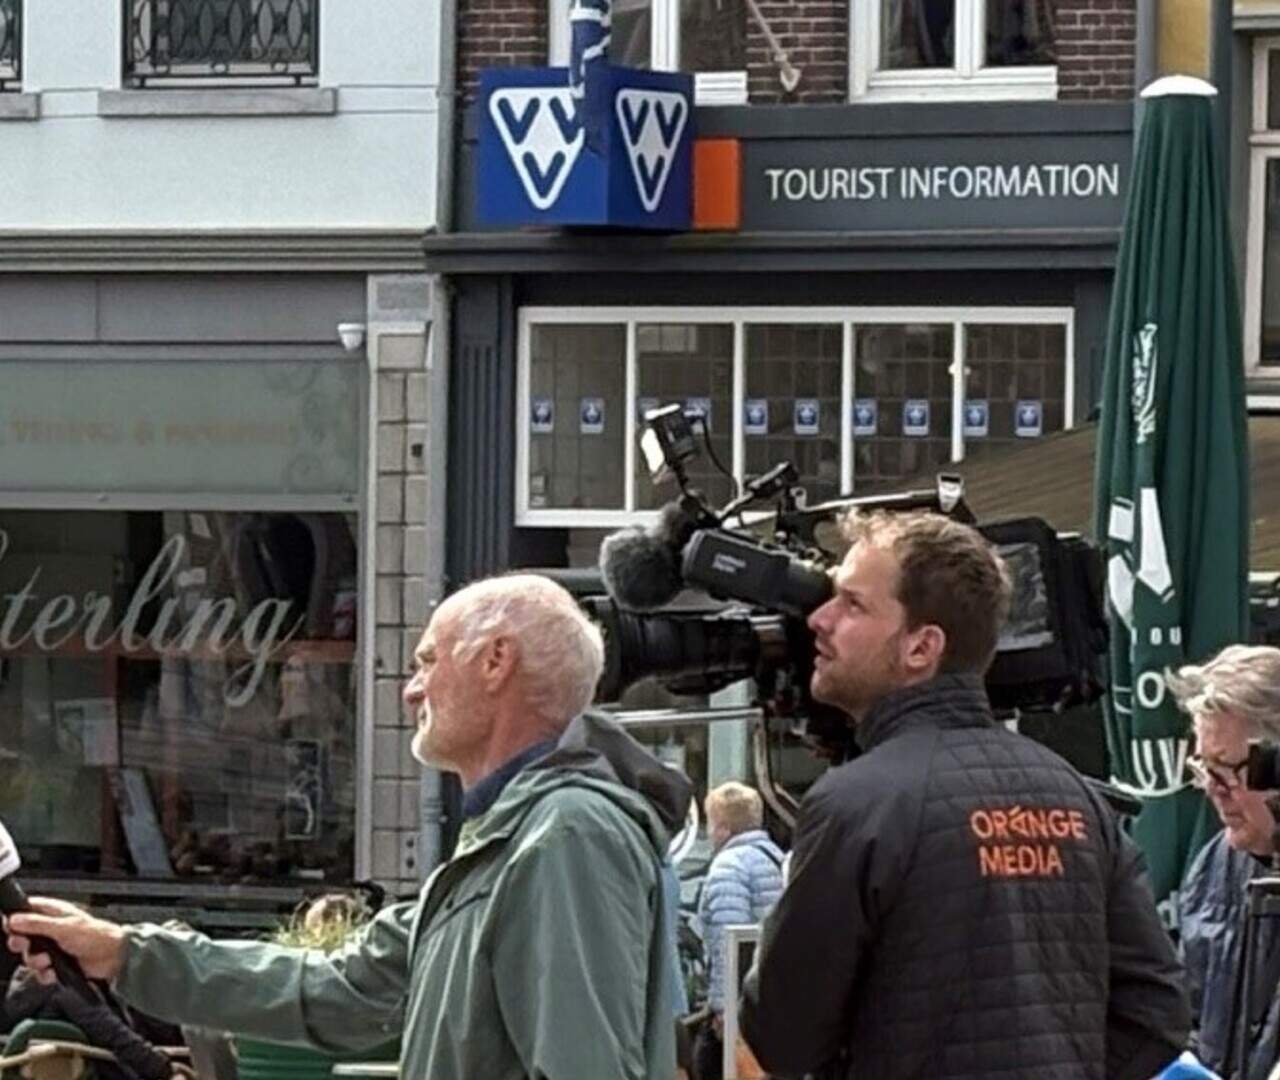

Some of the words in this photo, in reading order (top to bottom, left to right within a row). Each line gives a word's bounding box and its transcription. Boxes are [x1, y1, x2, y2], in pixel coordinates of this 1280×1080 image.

[765, 166, 895, 201] TOURIST
[900, 162, 1120, 198] INFORMATION
[978, 844, 1065, 877] MEDIA
